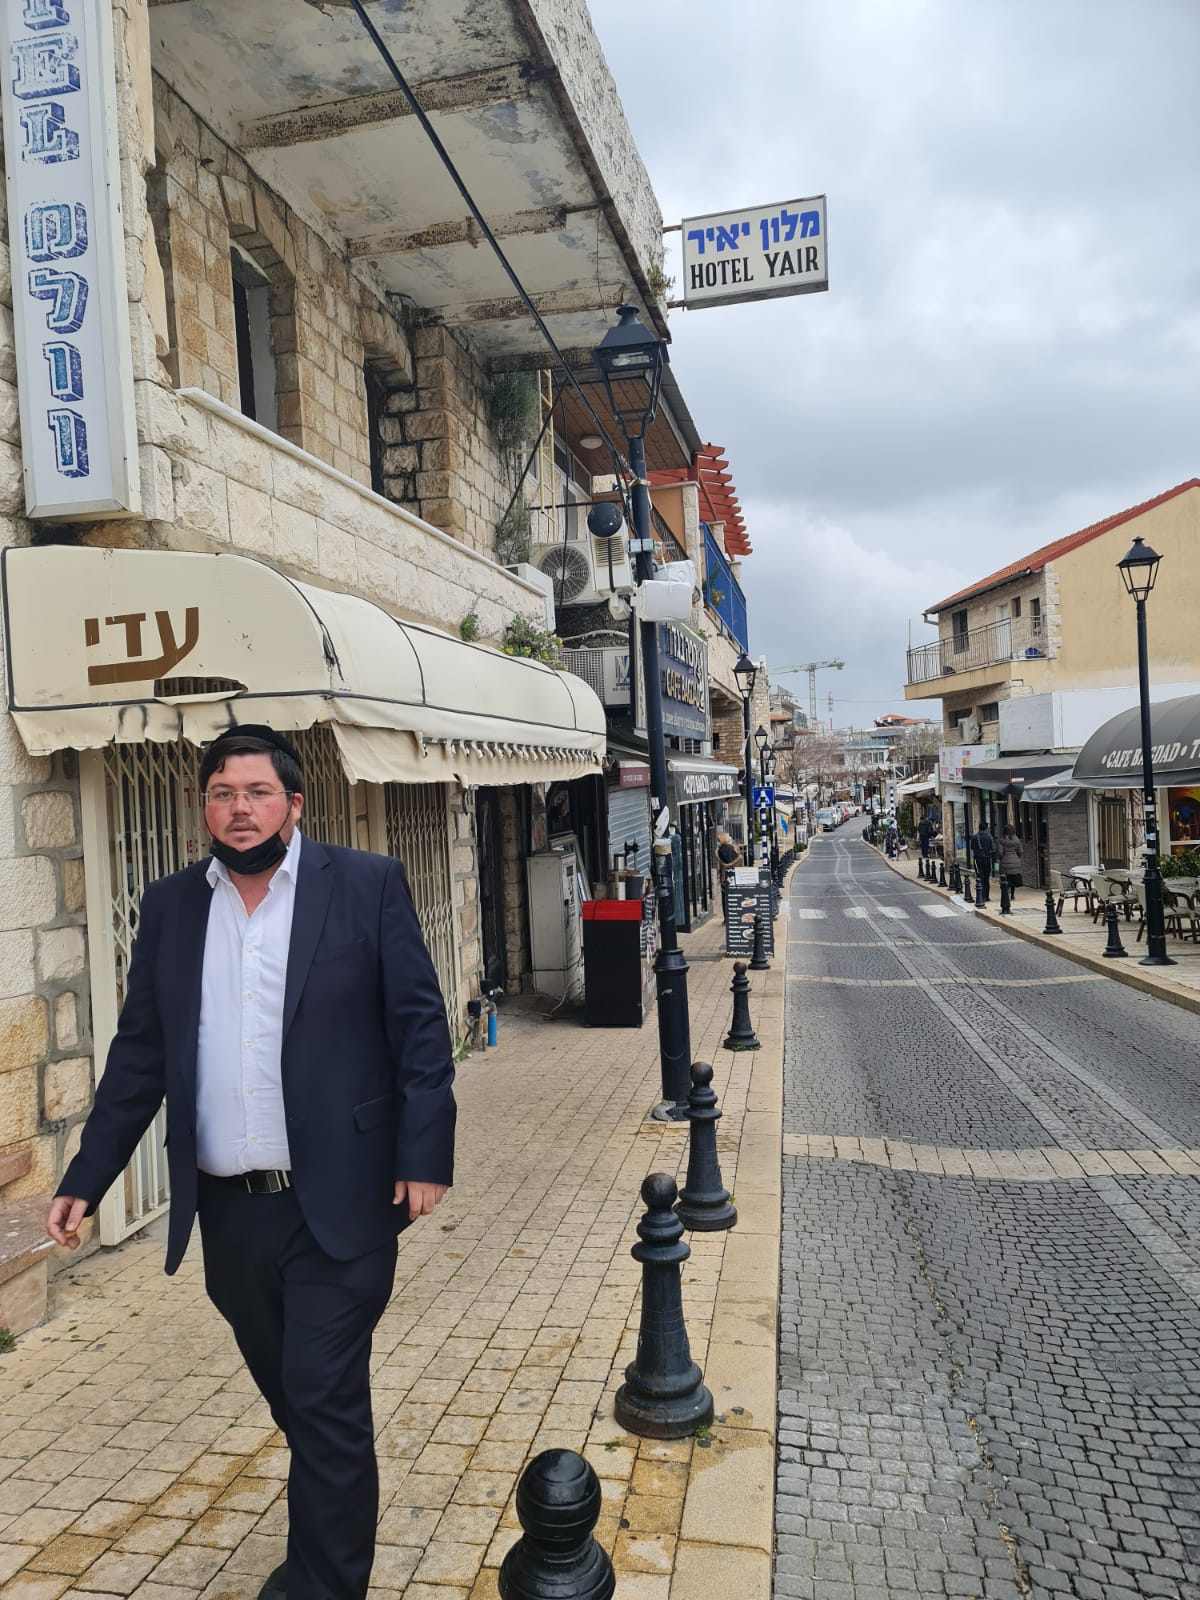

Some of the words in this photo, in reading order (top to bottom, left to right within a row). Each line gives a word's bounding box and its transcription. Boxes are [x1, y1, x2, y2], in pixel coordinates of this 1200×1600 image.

[687, 221, 750, 254] יאיר
[759, 209, 821, 251] מלון
[690, 256, 754, 290] HOTEL
[763, 245, 819, 278] YAIR
[84, 606, 199, 686] עדי
[1106, 749, 1134, 769] CAFE
